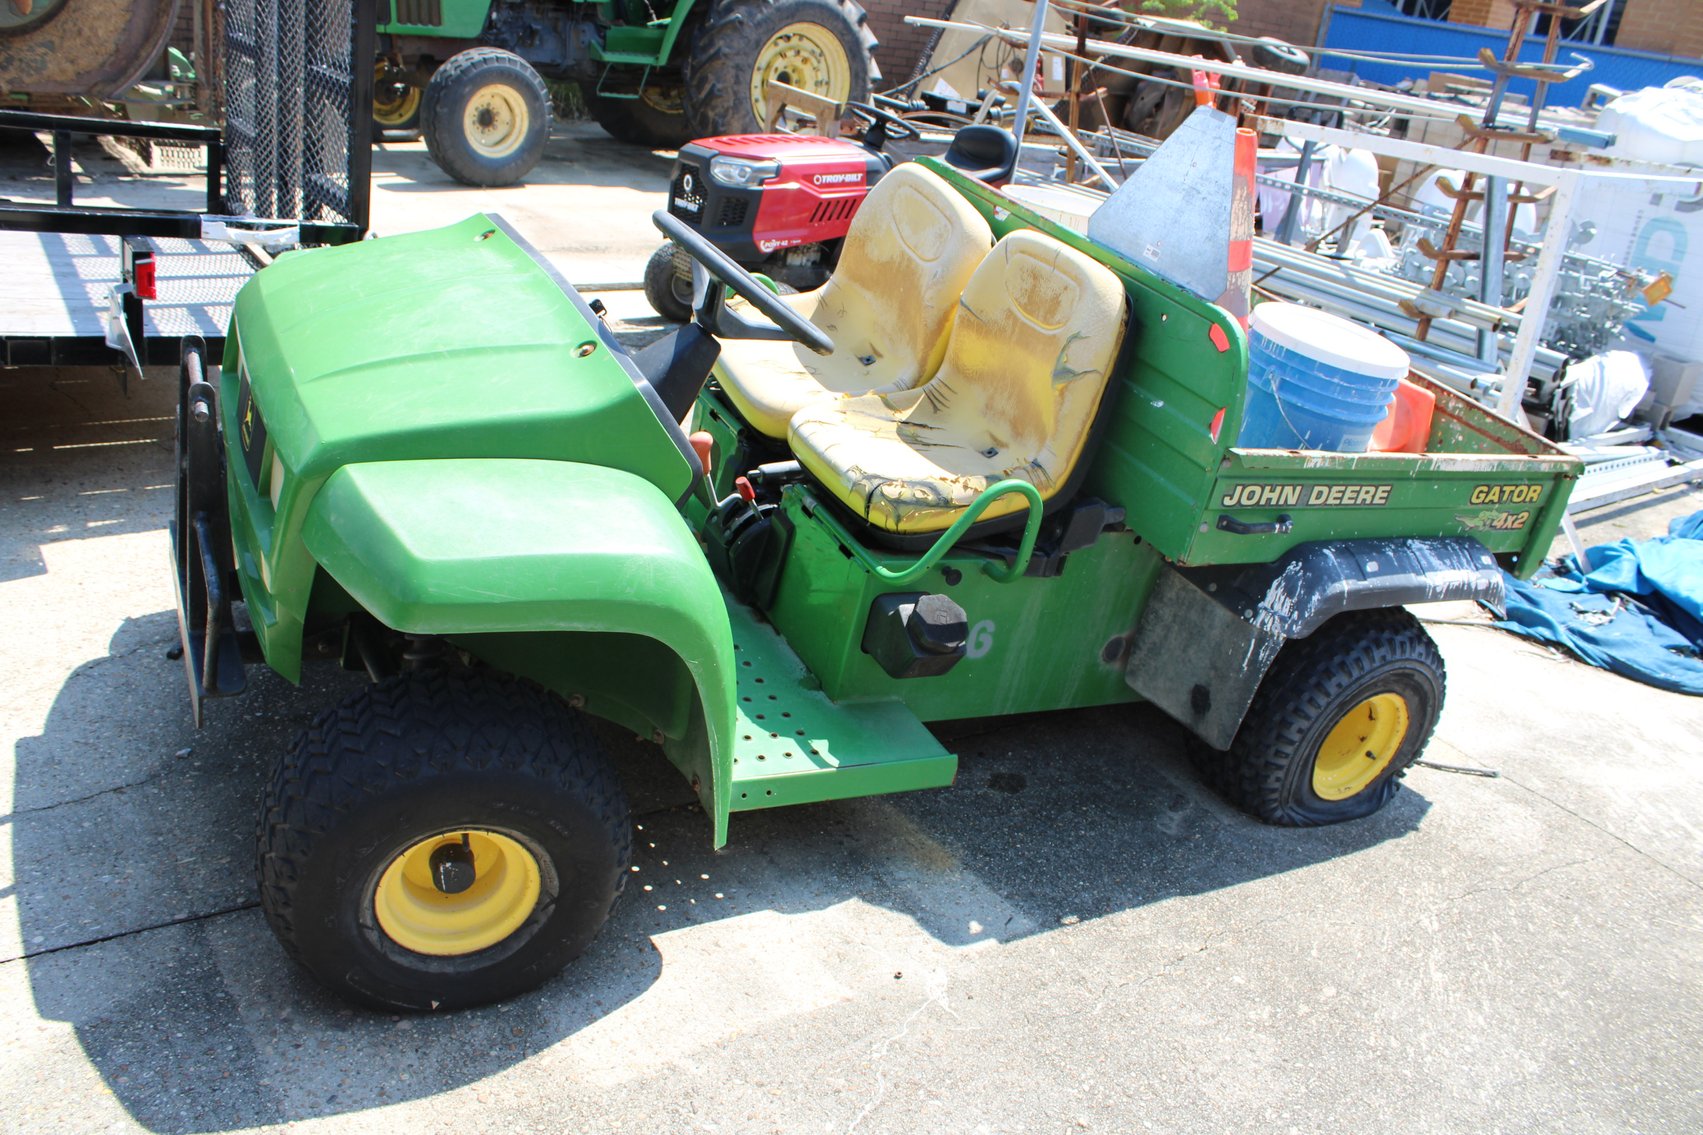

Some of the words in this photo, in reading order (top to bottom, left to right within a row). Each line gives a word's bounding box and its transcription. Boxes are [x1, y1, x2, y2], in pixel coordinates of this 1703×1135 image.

[821, 173, 864, 184] TROY-BILT
[1222, 484, 1303, 507] JOHN
[1306, 484, 1393, 507] DEERE
[1470, 484, 1543, 505] GATOR
